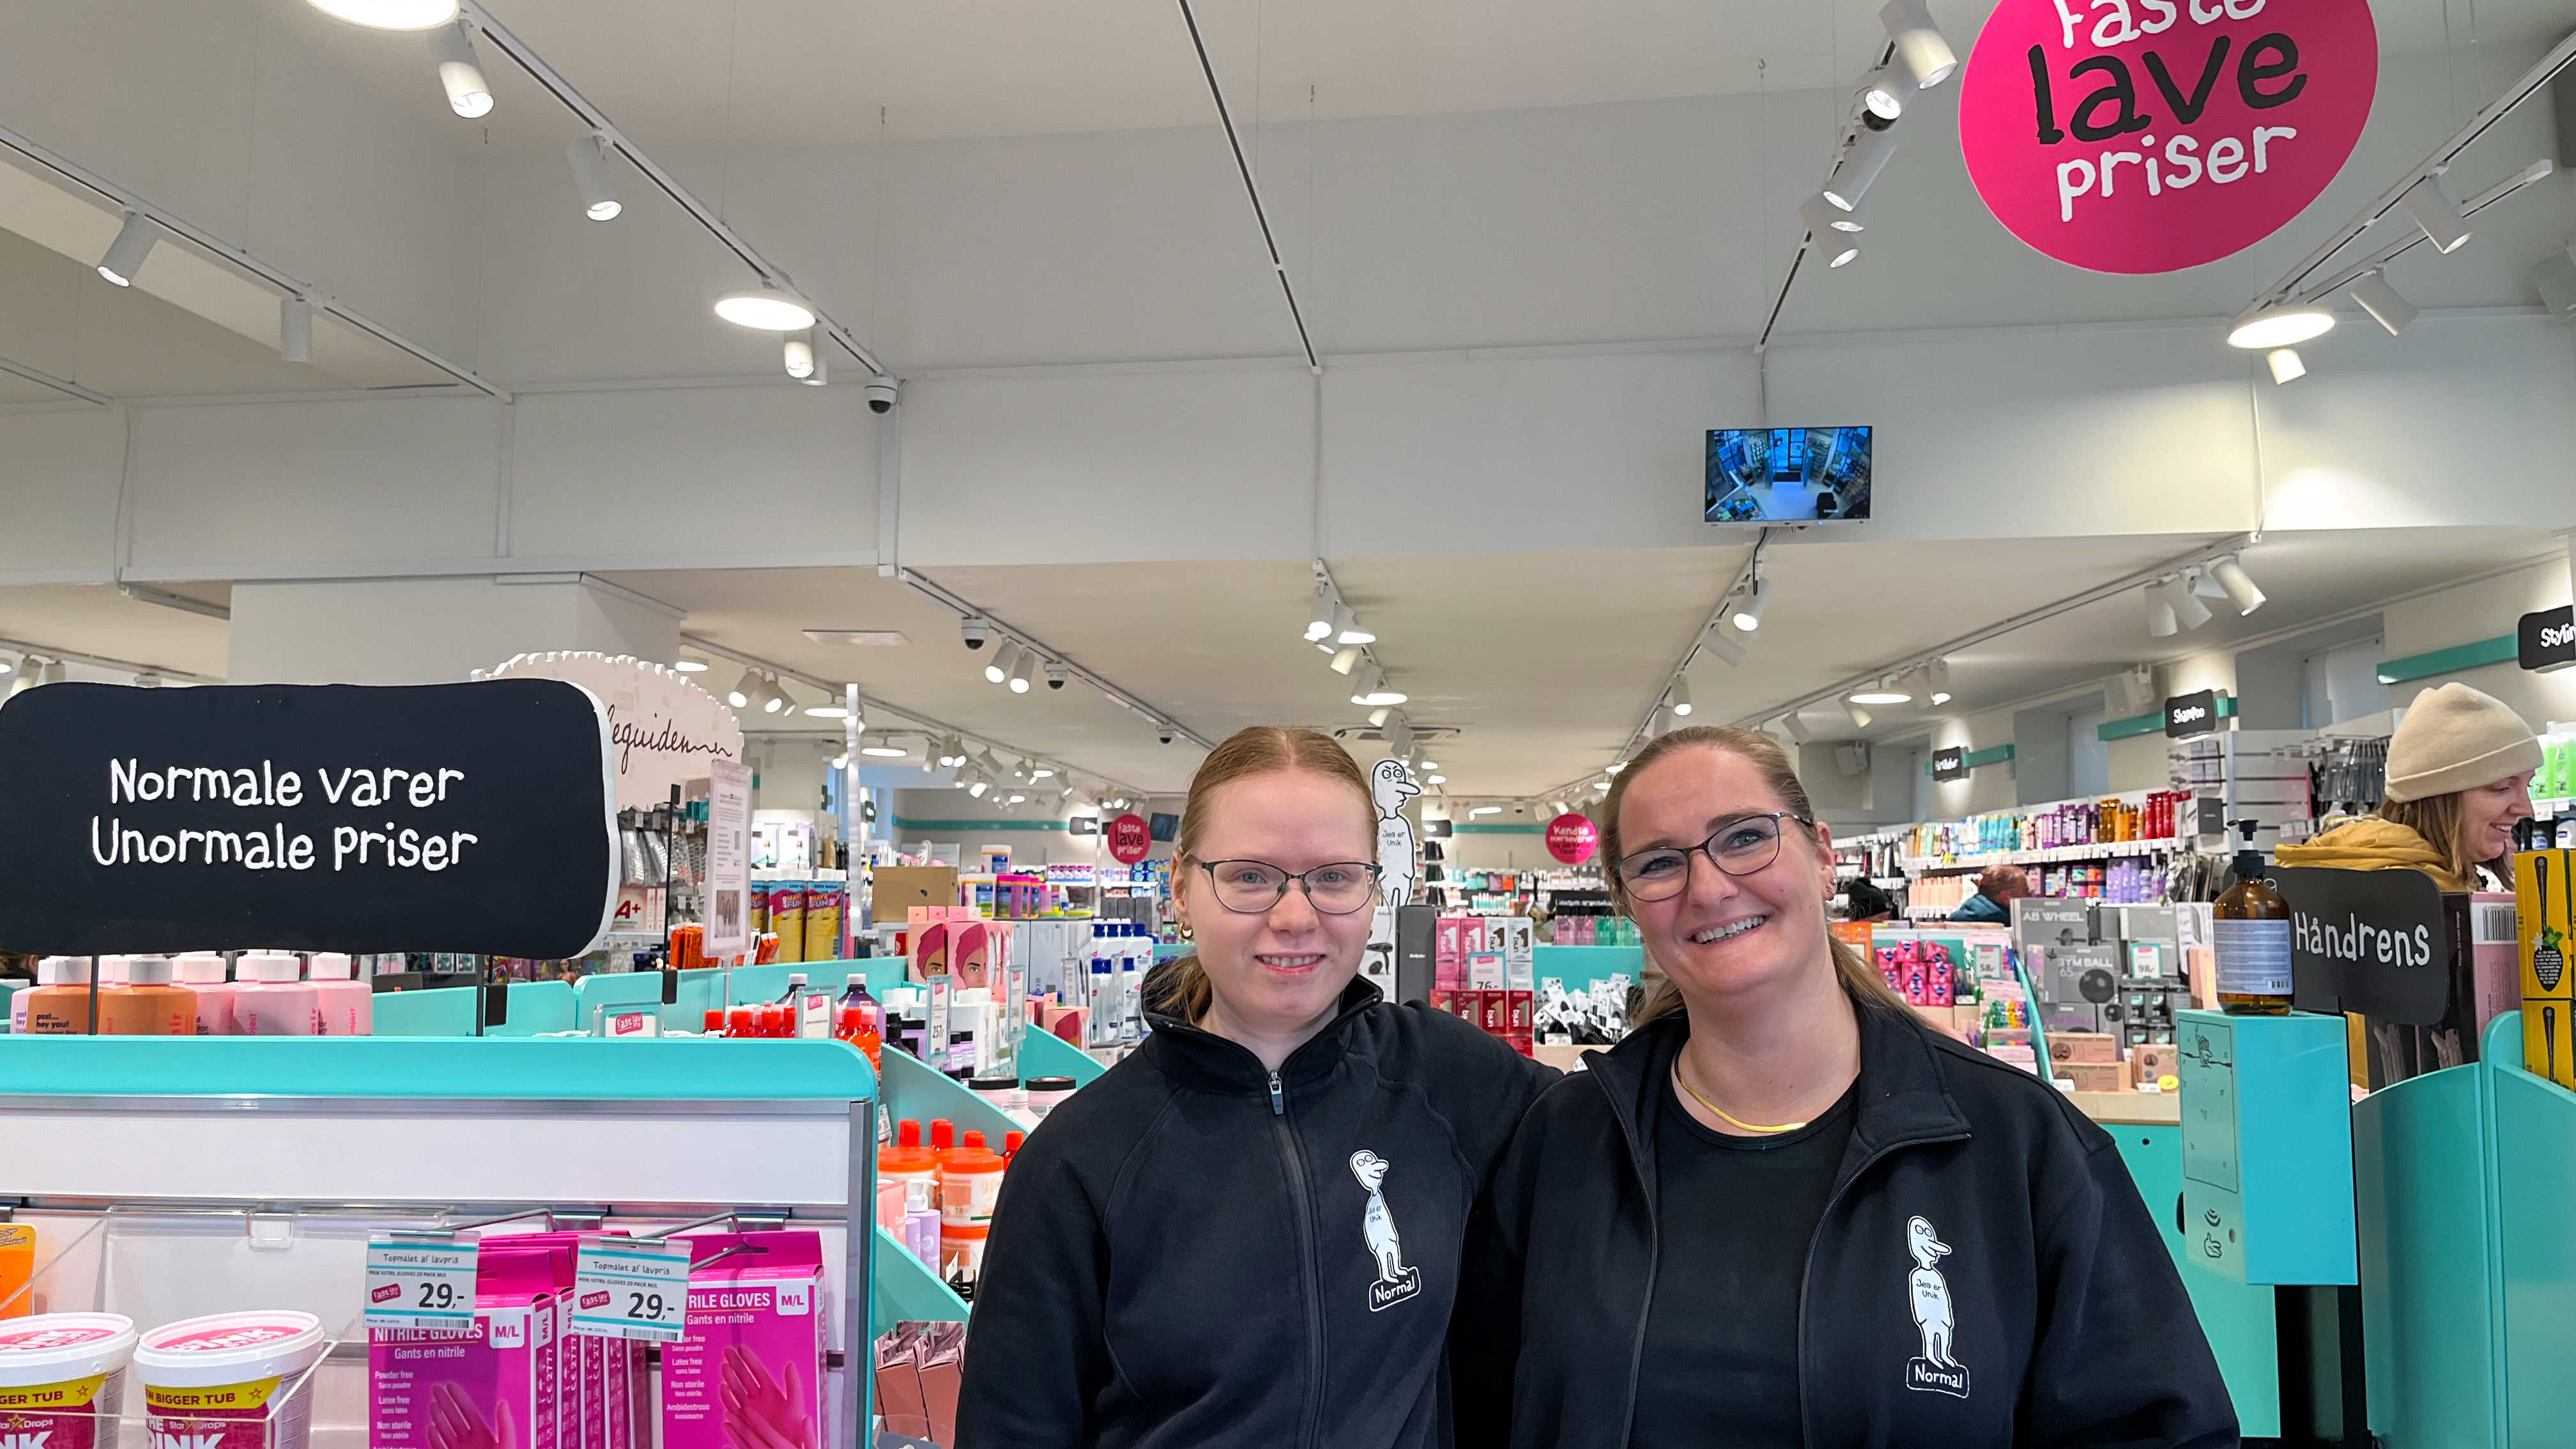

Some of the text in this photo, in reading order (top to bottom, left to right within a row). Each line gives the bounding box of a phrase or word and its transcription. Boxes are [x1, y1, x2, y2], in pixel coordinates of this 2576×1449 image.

[2028, 33, 2308, 144] lave
[2057, 126, 2297, 222] priser
[110, 758, 464, 808] Normale varer
[92, 815, 316, 870] Unormale
[1115, 831, 1144, 845] lave
[1118, 845, 1143, 856] priser
[615, 900, 641, 919] A+
[2043, 912, 2085, 922] WHEEL
[2294, 912, 2430, 967] Håndrens
[2084, 958, 2113, 967] BALL
[431, 1255, 459, 1264] lavpris
[631, 1264, 641, 1273] af
[642, 1265, 670, 1276] lavpris
[1375, 1275, 1415, 1303] Normal
[1922, 1289, 1940, 1300] Unik
[419, 1282, 465, 1309] 29,-
[687, 1292, 770, 1308] RILE GLOVES
[781, 1295, 804, 1307] M/L
[627, 1292, 675, 1321] 29,-
[687, 1313, 755, 1325] Gants en nitrile
[375, 1324, 483, 1342] NITRILE GLOVES
[495, 1326, 520, 1338] M/L
[693, 1335, 705, 1343] free
[395, 1346, 465, 1360] Gants en nitrile
[672, 1358, 703, 1366] Latex free
[375, 1370, 414, 1380] Powder free
[1915, 1363, 1963, 1389] Normal
[684, 1380, 705, 1388] sterile
[0, 1391, 63, 1405] GER TUB
[156, 1393, 199, 1406] BIGGER
[204, 1393, 235, 1404] TUB
[378, 1397, 396, 1405] Latex
[24, 1418, 54, 1429] Drops
[169, 1421, 185, 1430] Star
[377, 1420, 411, 1430] Non sterile
